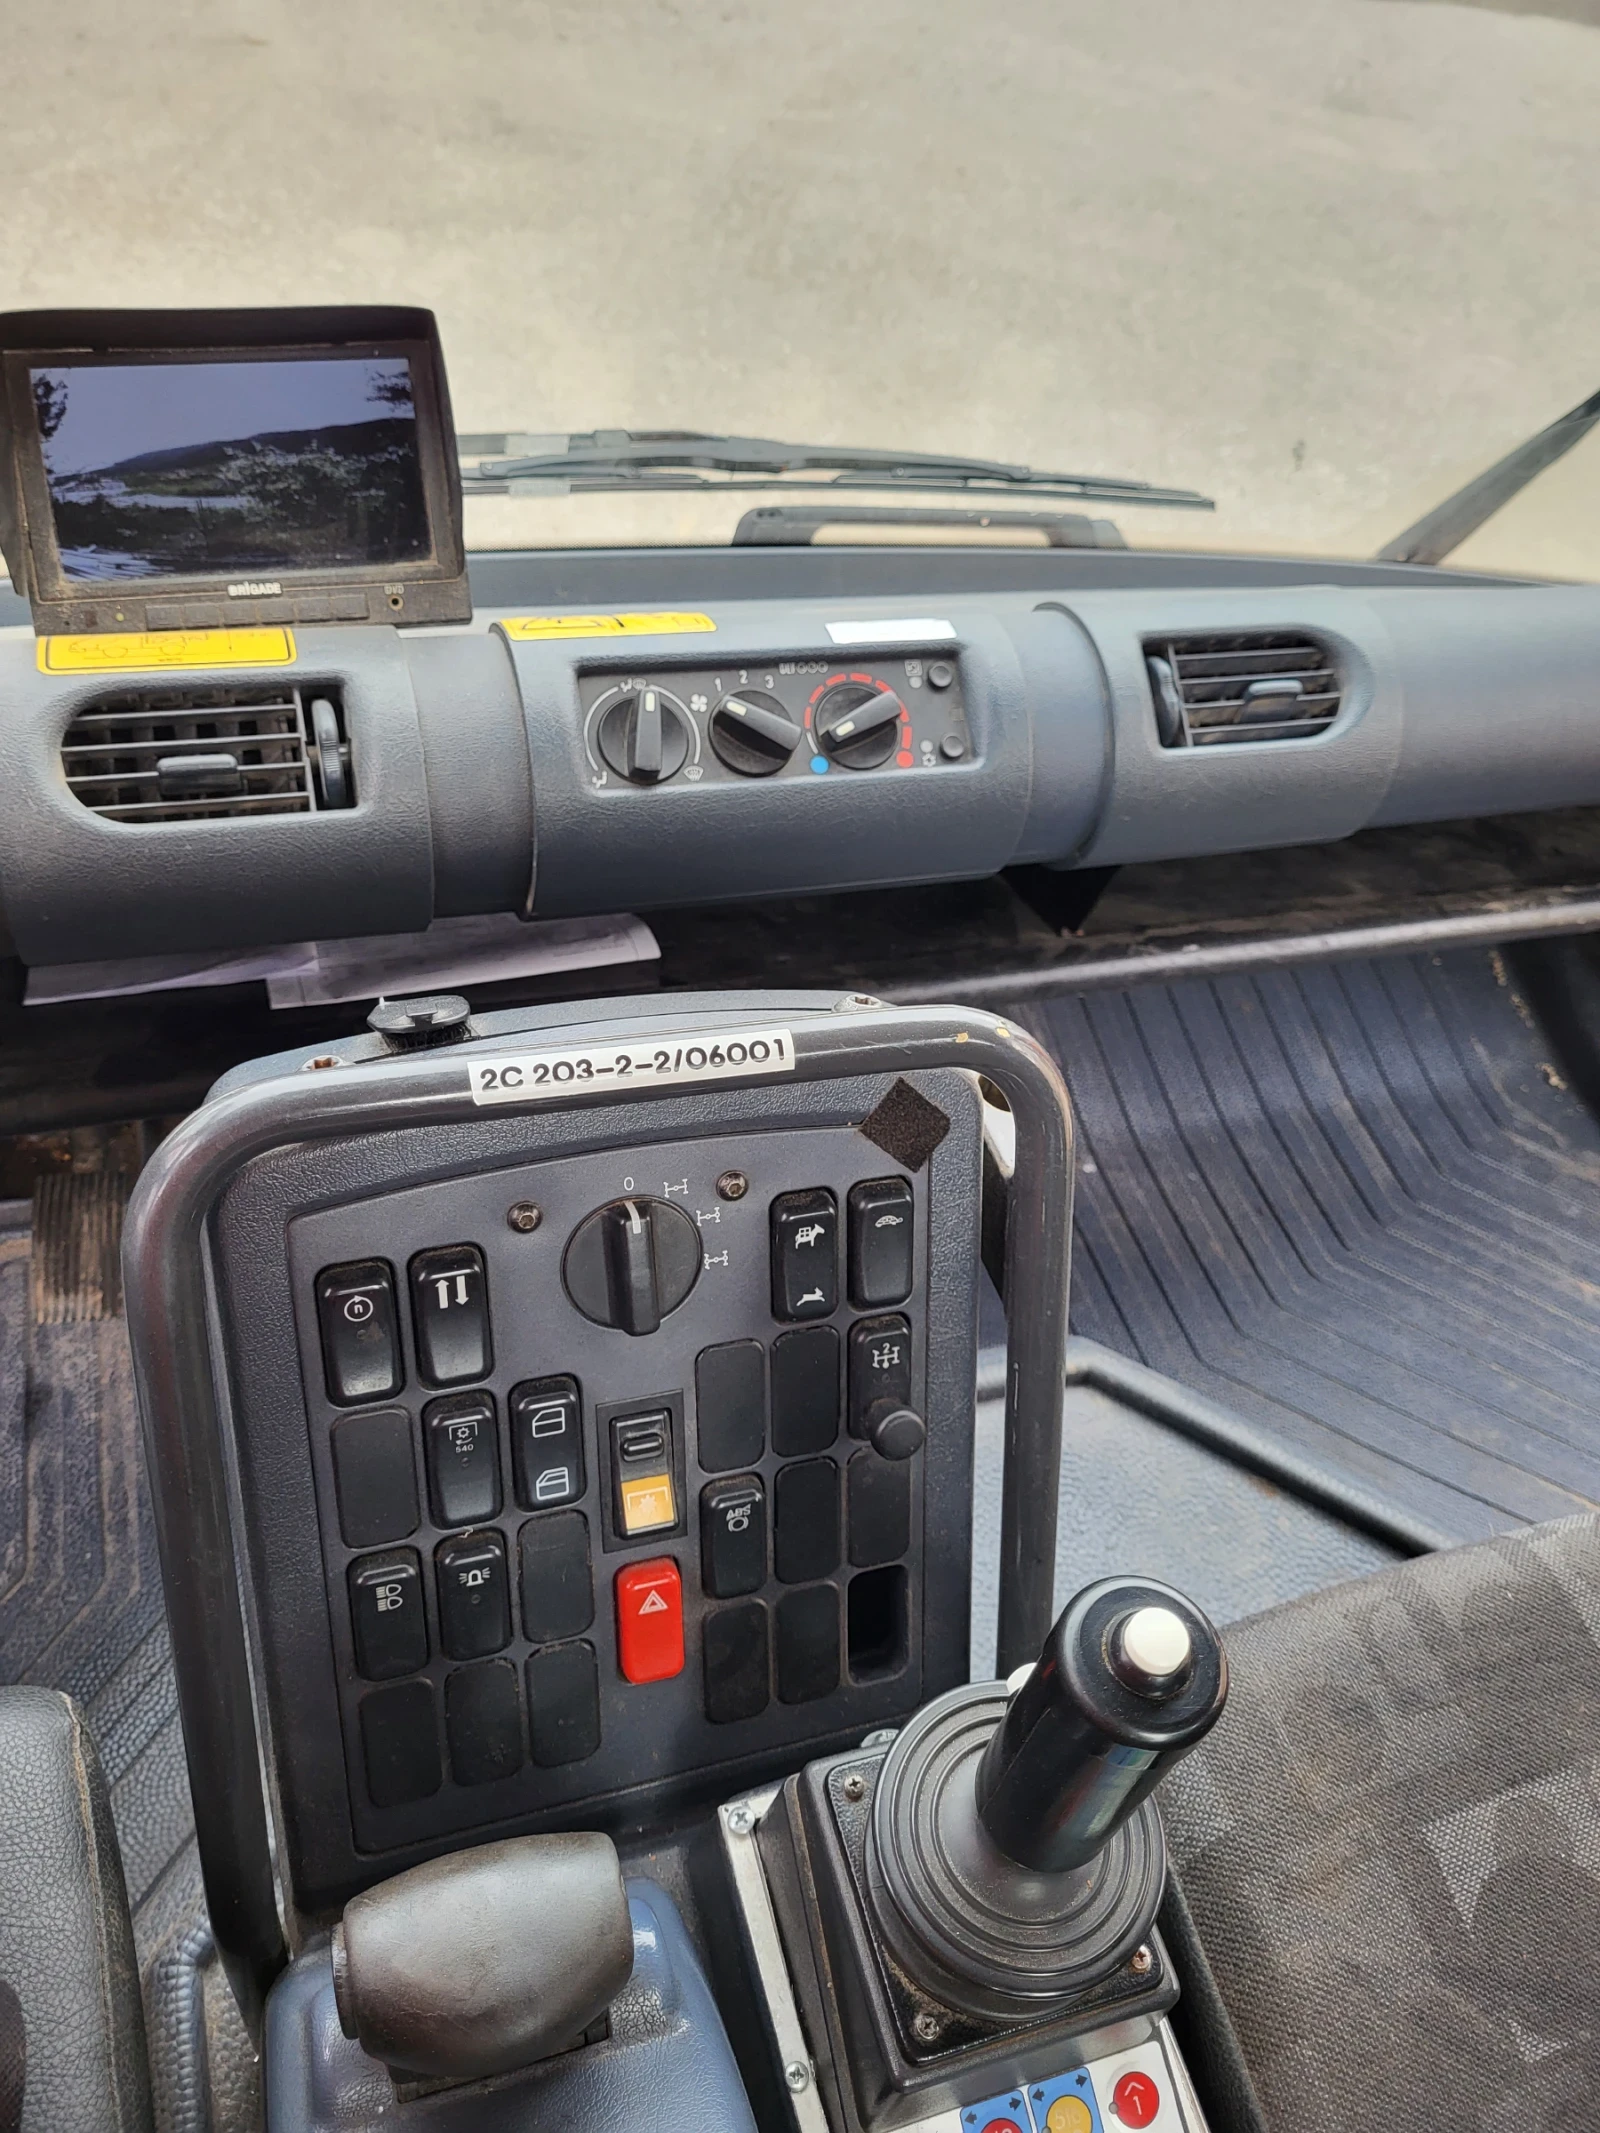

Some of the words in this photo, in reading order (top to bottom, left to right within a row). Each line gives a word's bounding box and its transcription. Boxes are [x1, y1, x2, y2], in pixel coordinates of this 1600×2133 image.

[227, 581, 282, 597] BRIGADE
[714, 677, 722, 692] 1
[739, 669, 749, 684] 2
[764, 674, 774, 689] 3
[480, 1066, 524, 1092] 2C
[882, 1342, 891, 1354] 2
[455, 1443, 474, 1454] 540
[726, 1503, 751, 1521] ABS
